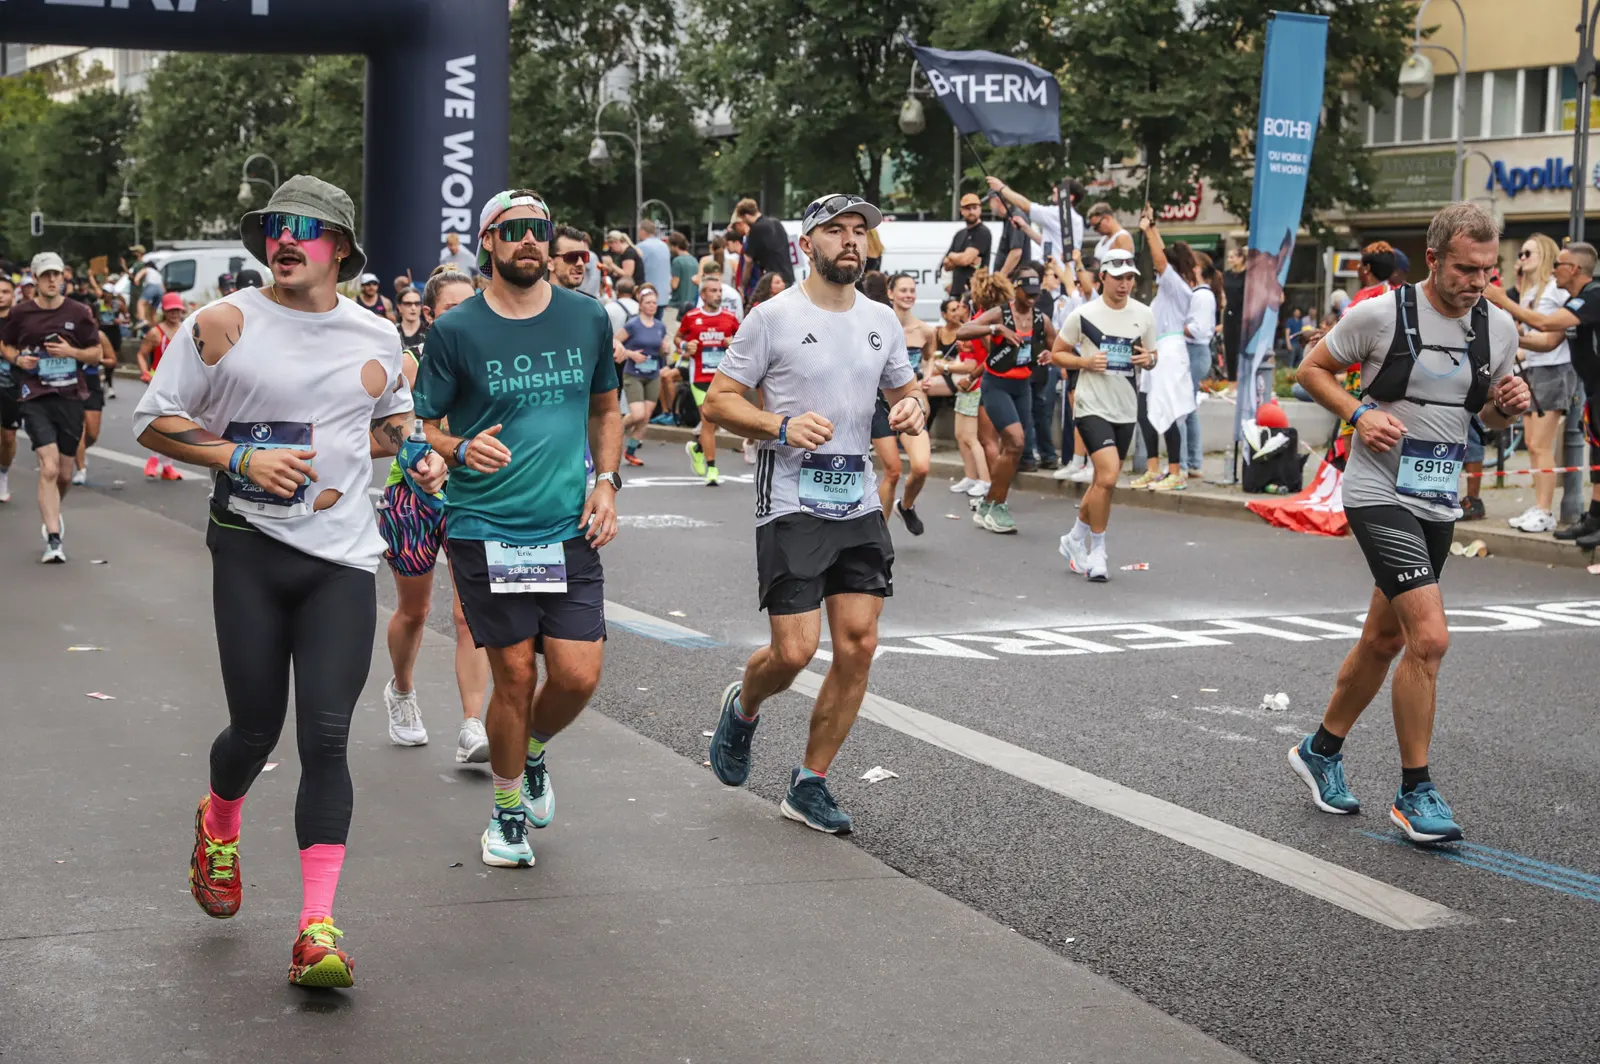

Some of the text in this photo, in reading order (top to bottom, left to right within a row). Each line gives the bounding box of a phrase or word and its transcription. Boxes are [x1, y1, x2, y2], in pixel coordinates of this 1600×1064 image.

[444, 54, 476, 119] WE
[1107, 344, 1131, 353] 5689
[486, 347, 583, 378] ROTH
[489, 369, 584, 396] FINISHER
[516, 389, 565, 409] 2025
[813, 470, 856, 486] 83370
[508, 565, 546, 575] zalando
